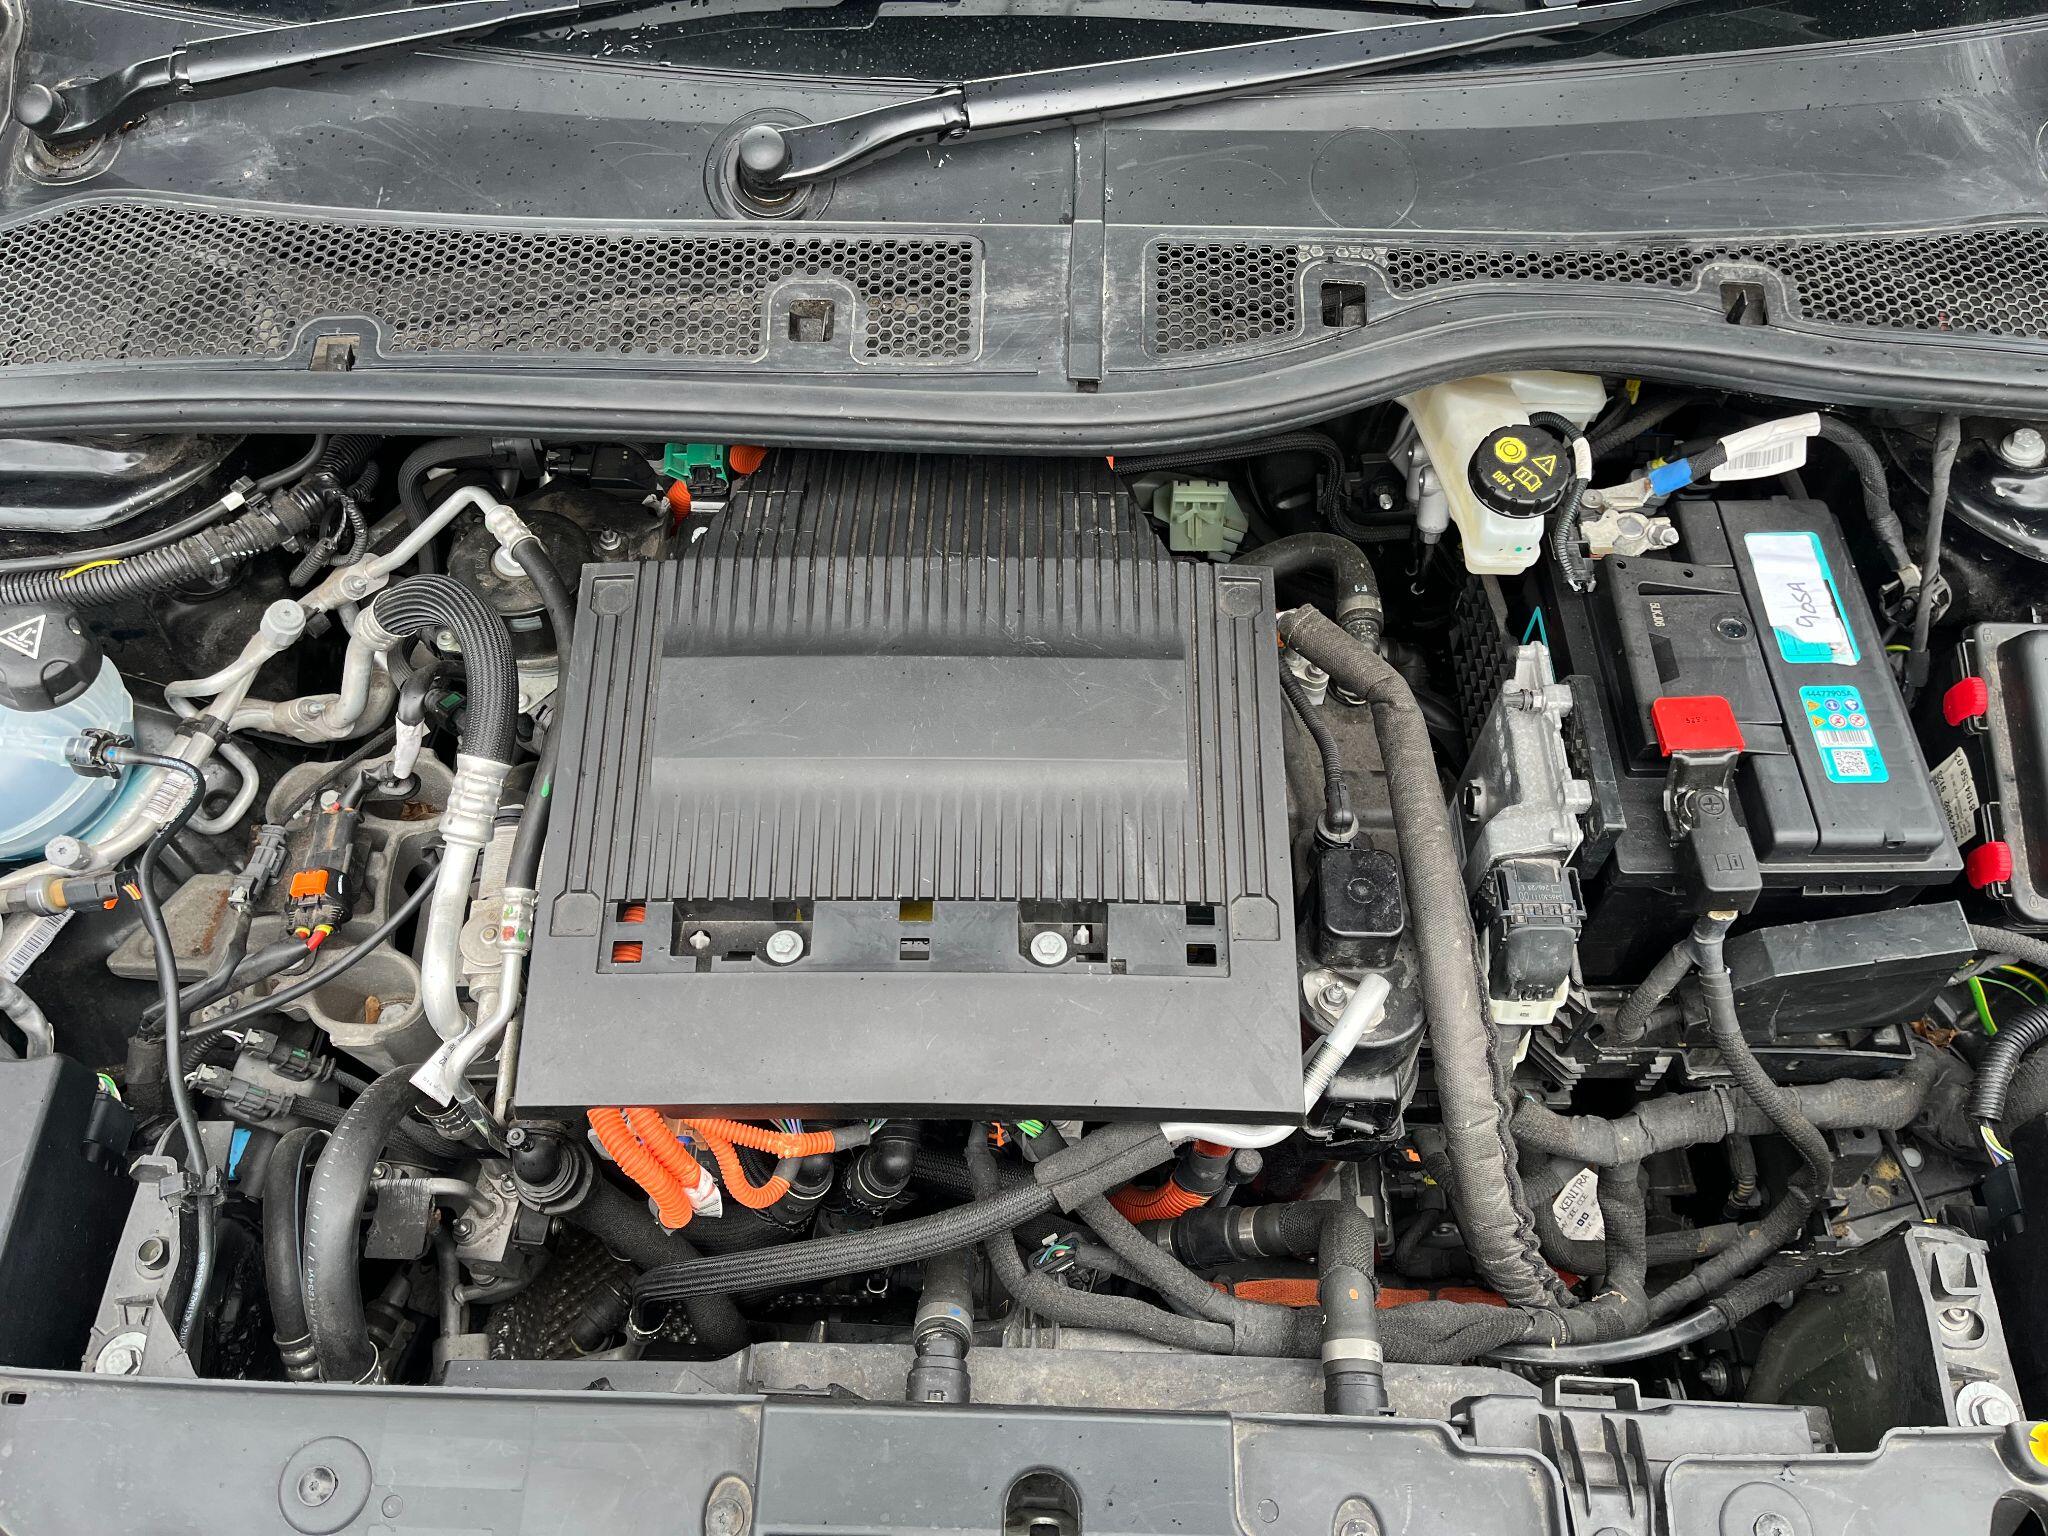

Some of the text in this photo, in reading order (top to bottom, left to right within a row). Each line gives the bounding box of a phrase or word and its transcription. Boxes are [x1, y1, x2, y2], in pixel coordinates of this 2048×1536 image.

[1492, 470, 1515, 491] DOT 4
[1354, 584, 1368, 593] F1
[1559, 1174, 1590, 1212] KENITRA
